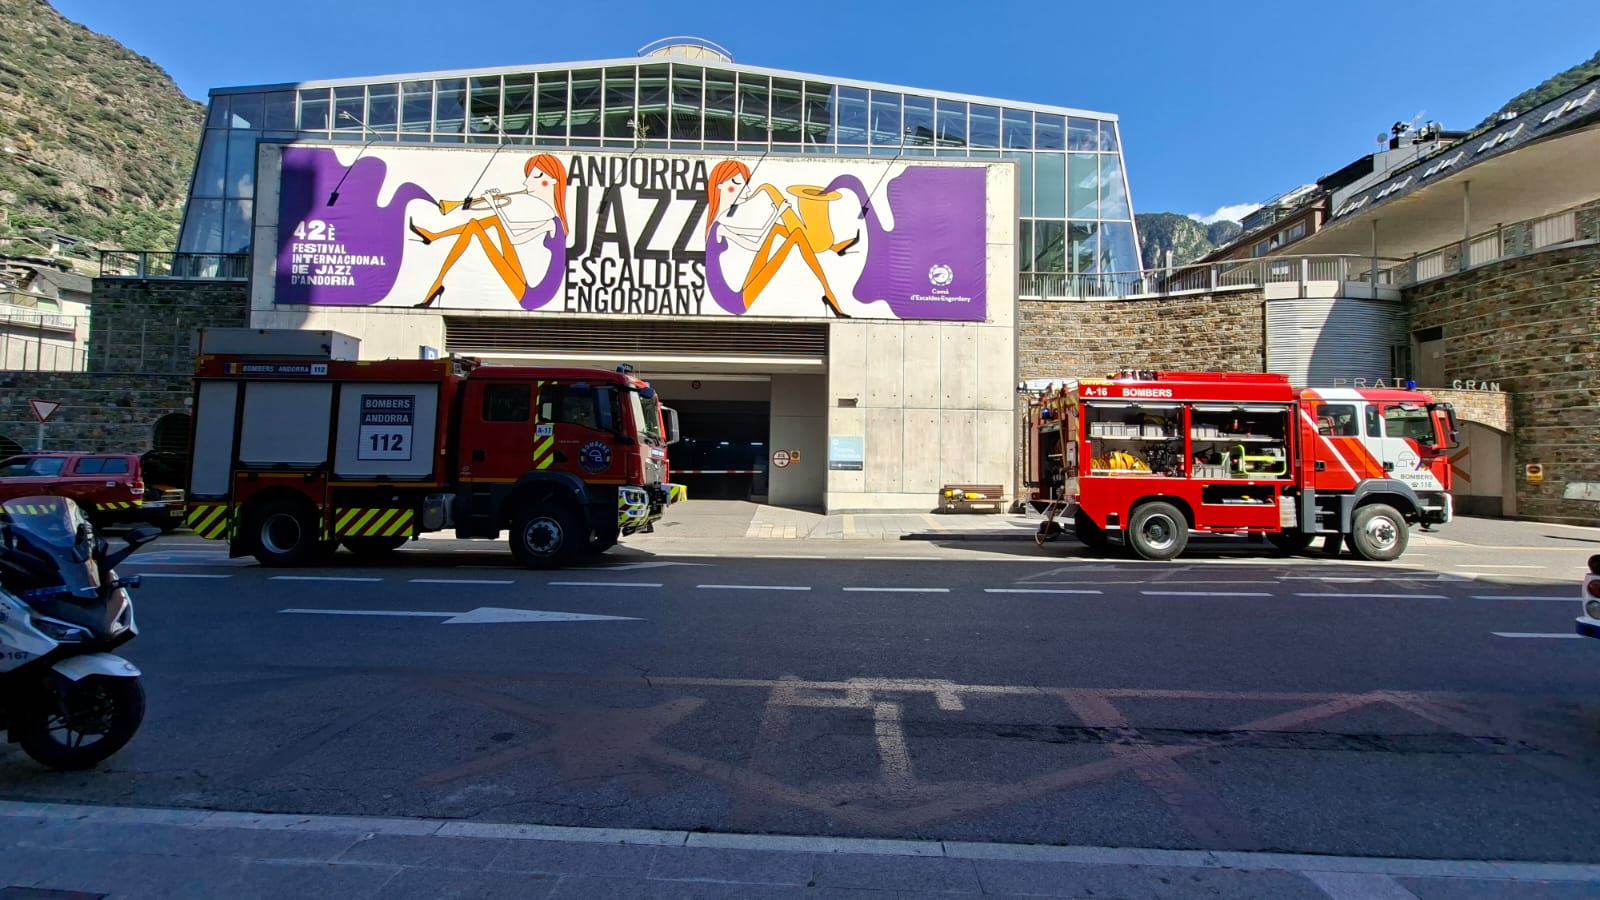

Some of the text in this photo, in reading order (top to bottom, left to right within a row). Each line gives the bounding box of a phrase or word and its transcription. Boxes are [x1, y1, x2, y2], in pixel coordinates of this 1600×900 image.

[567, 155, 708, 191] ANDORRA
[566, 186, 709, 261] JAZZ
[293, 220, 335, 241] 42È
[292, 243, 347, 254] FESTIVAL
[292, 254, 386, 266] INTERNACIONAL
[292, 264, 352, 275] DE JAZZ
[565, 257, 706, 289] ESCALDES
[291, 275, 355, 286] D'ANDORRA
[564, 286, 705, 315] ENGORDANY
[1333, 377, 1500, 392] PRAT GRAN
[1085, 387, 1173, 397] A-16 BOMBERS
[365, 399, 410, 408] BOMBERS
[365, 414, 409, 423] ANDORRA
[370, 433, 403, 451] 112
